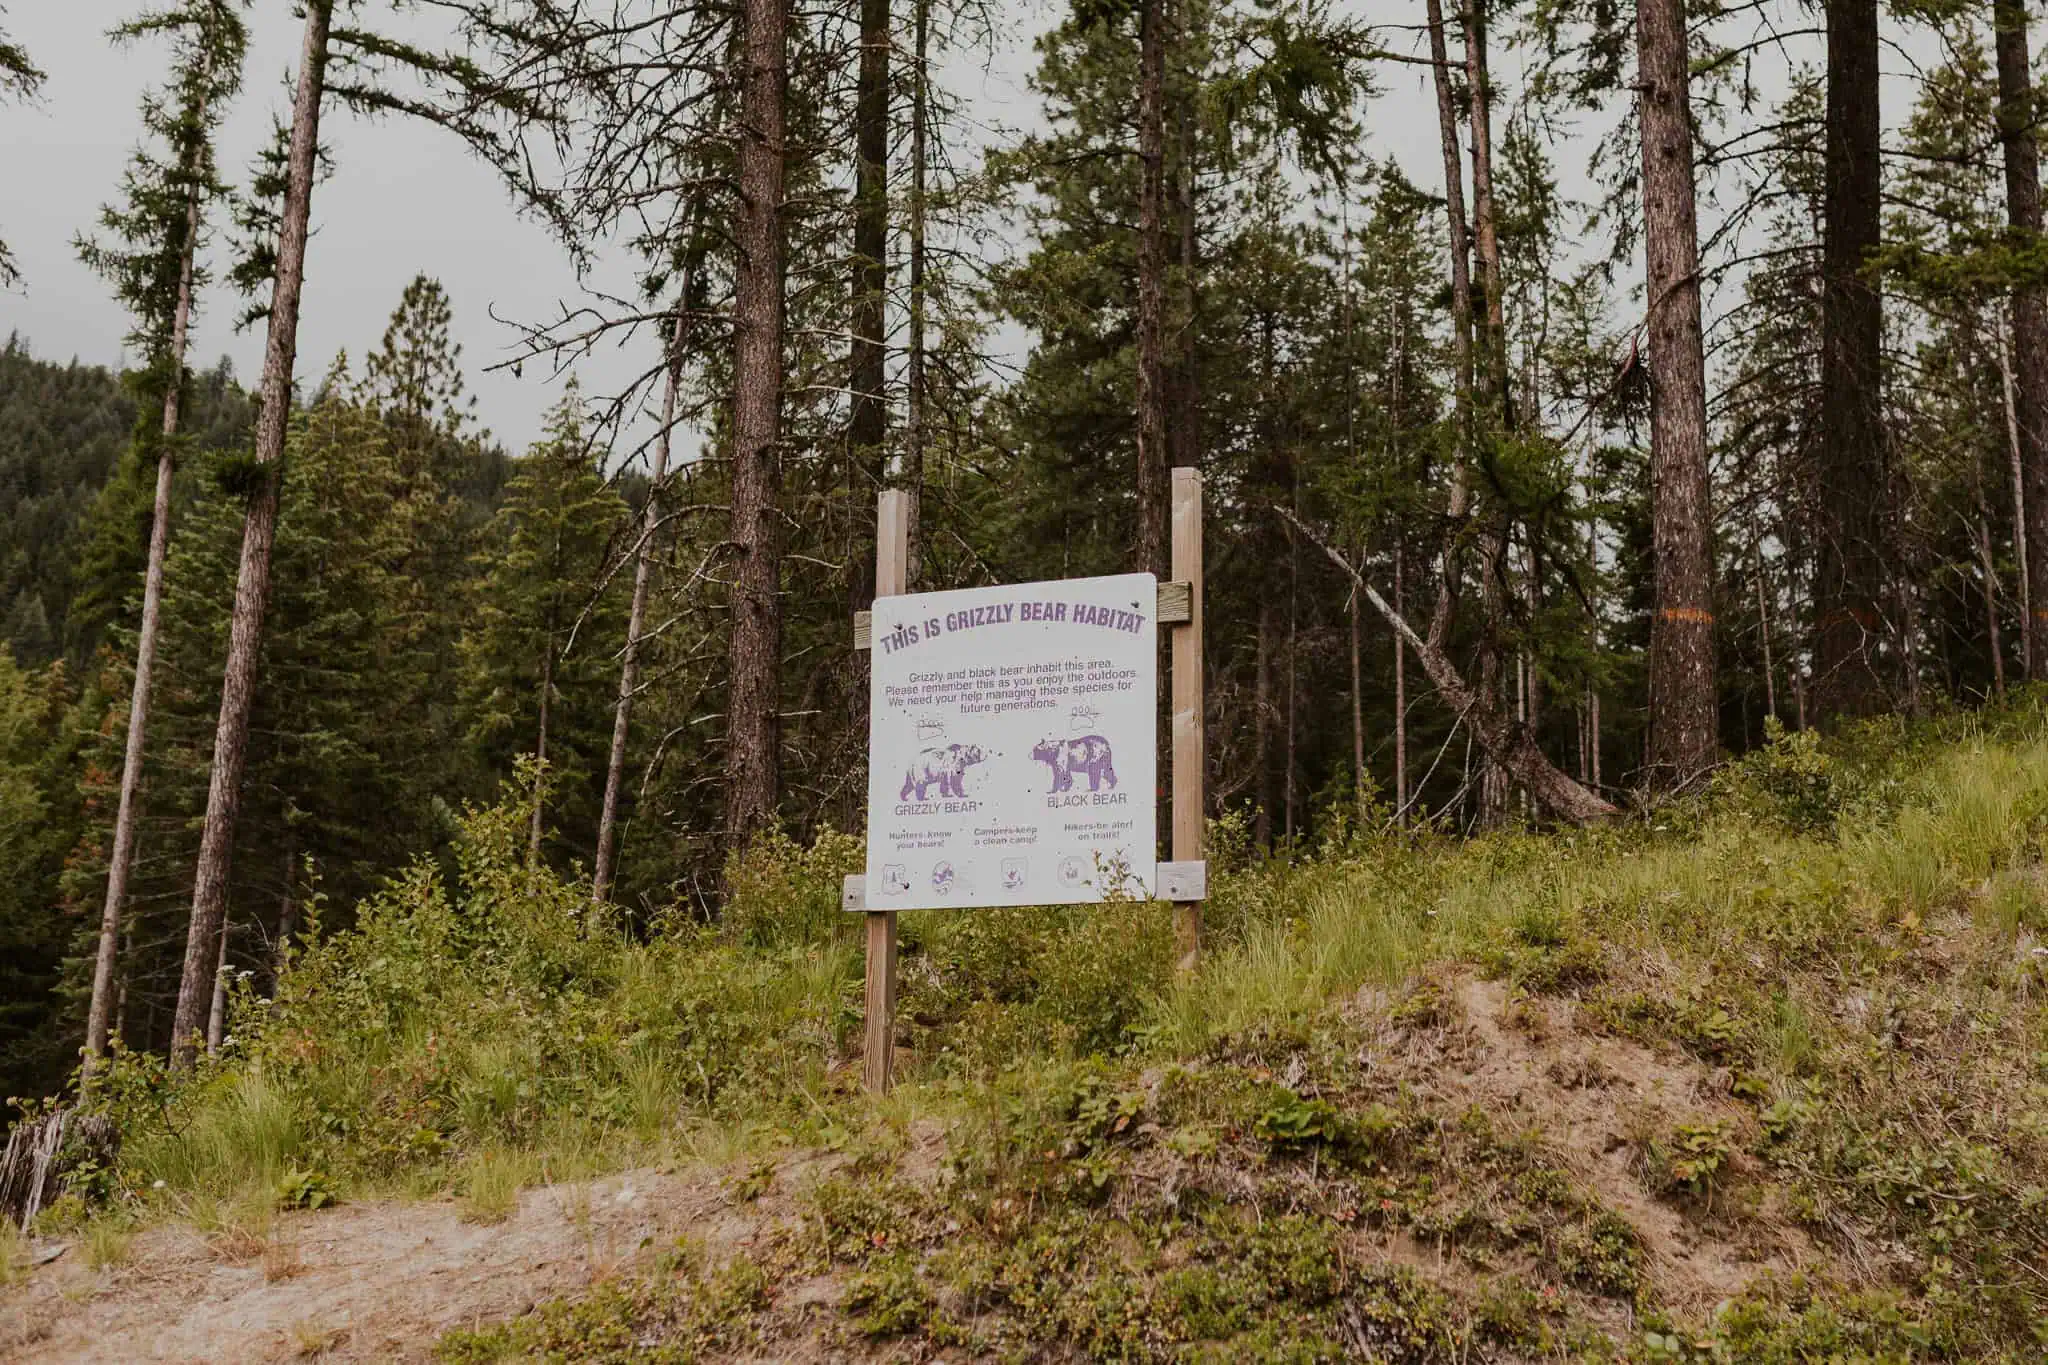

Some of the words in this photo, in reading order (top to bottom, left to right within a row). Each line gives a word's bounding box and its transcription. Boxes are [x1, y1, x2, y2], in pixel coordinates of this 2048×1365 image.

[880, 625, 919, 655] THIS
[924, 618, 941, 639] IS
[946, 603, 1014, 632] GRIZZLY
[1020, 602, 1067, 621] BEAR
[1072, 604, 1146, 634] HABITAT
[909, 672, 943, 683] Grizzly
[947, 668, 966, 680] and
[969, 667, 996, 679] black
[1000, 665, 1023, 676] bear
[1027, 662, 1061, 673] inhabit
[1065, 660, 1084, 671] this
[1088, 660, 1113, 670] area.
[885, 686, 918, 696] Please
[922, 681, 973, 693] remember
[976, 679, 994, 689] this
[998, 679, 1010, 689] as
[1014, 677, 1032, 688] you
[1036, 675, 1063, 686] enjoy
[1068, 672, 1084, 682] the
[889, 697, 904, 707] We
[907, 694, 932, 705] need
[936, 694, 957, 706] your
[961, 692, 982, 703] help
[986, 689, 1036, 700] managing
[1040, 685, 1068, 696] these
[1072, 683, 1114, 696] species
[1118, 680, 1133, 691] for
[960, 703, 990, 713] future
[994, 699, 1058, 713] generations.
[1047, 794, 1088, 808] BLACK
[1093, 793, 1127, 805] BEAR
[895, 803, 941, 816] GRIZZLY
[945, 801, 977, 813] BEAR
[1112, 819, 1133, 830] alert
[983, 838, 1007, 846] clean
[1078, 833, 1090, 841] on
[897, 841, 914, 852] your
